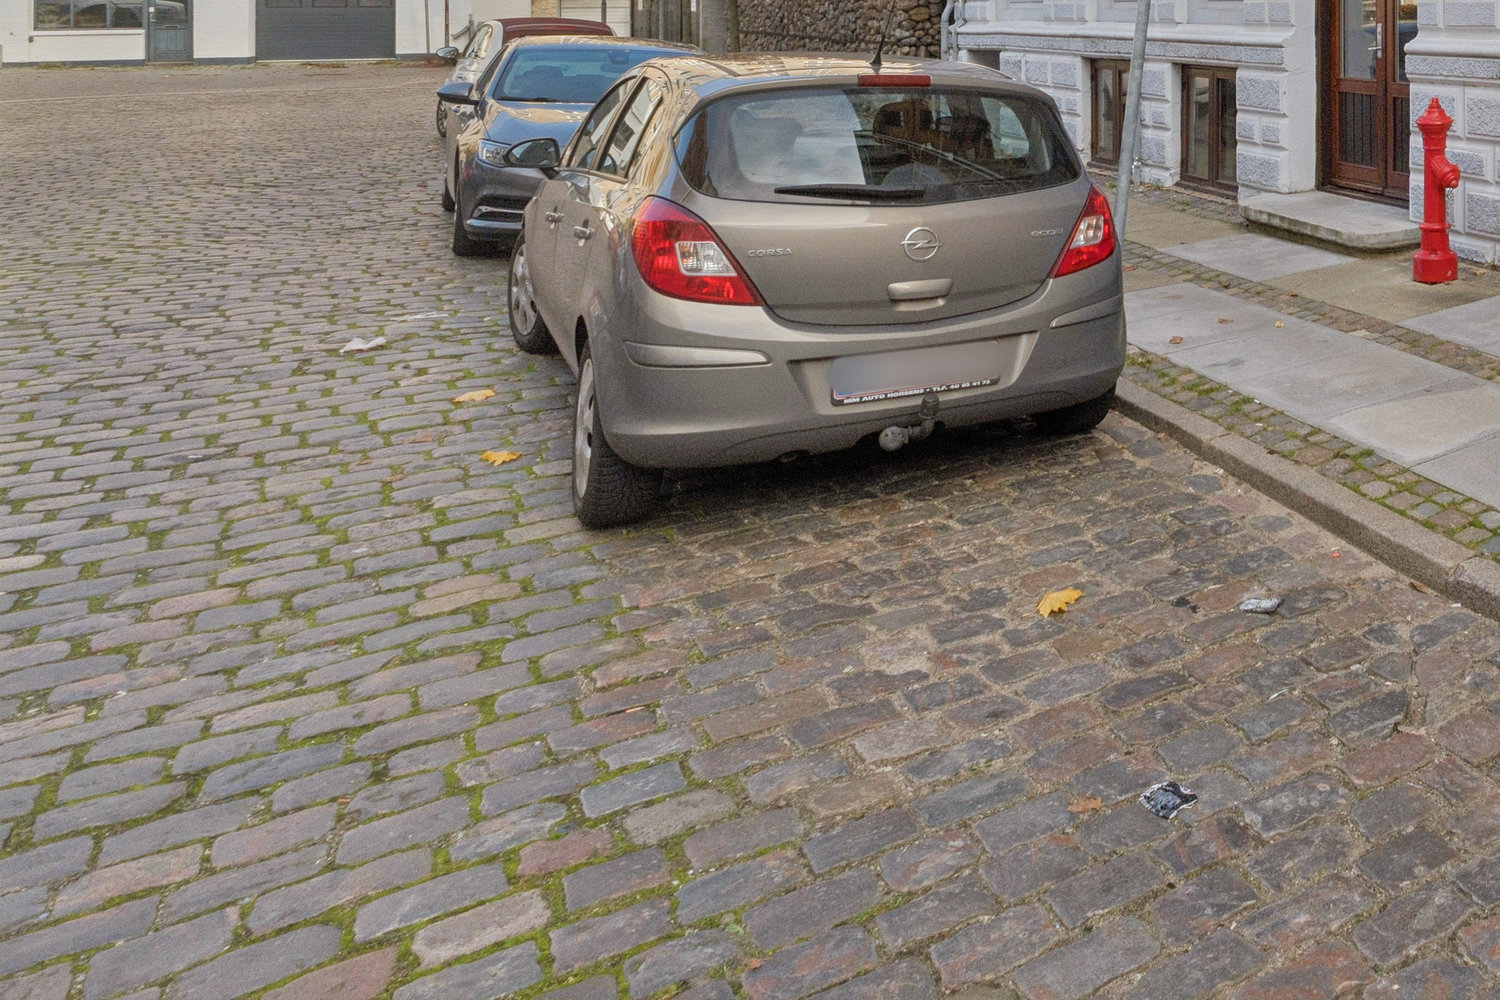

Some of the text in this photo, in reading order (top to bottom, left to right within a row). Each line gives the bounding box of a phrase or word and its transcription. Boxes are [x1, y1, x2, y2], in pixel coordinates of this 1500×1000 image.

[747, 248, 792, 257] CORSA
[861, 394, 886, 402] AUTO
[886, 388, 925, 398] HORSENS
